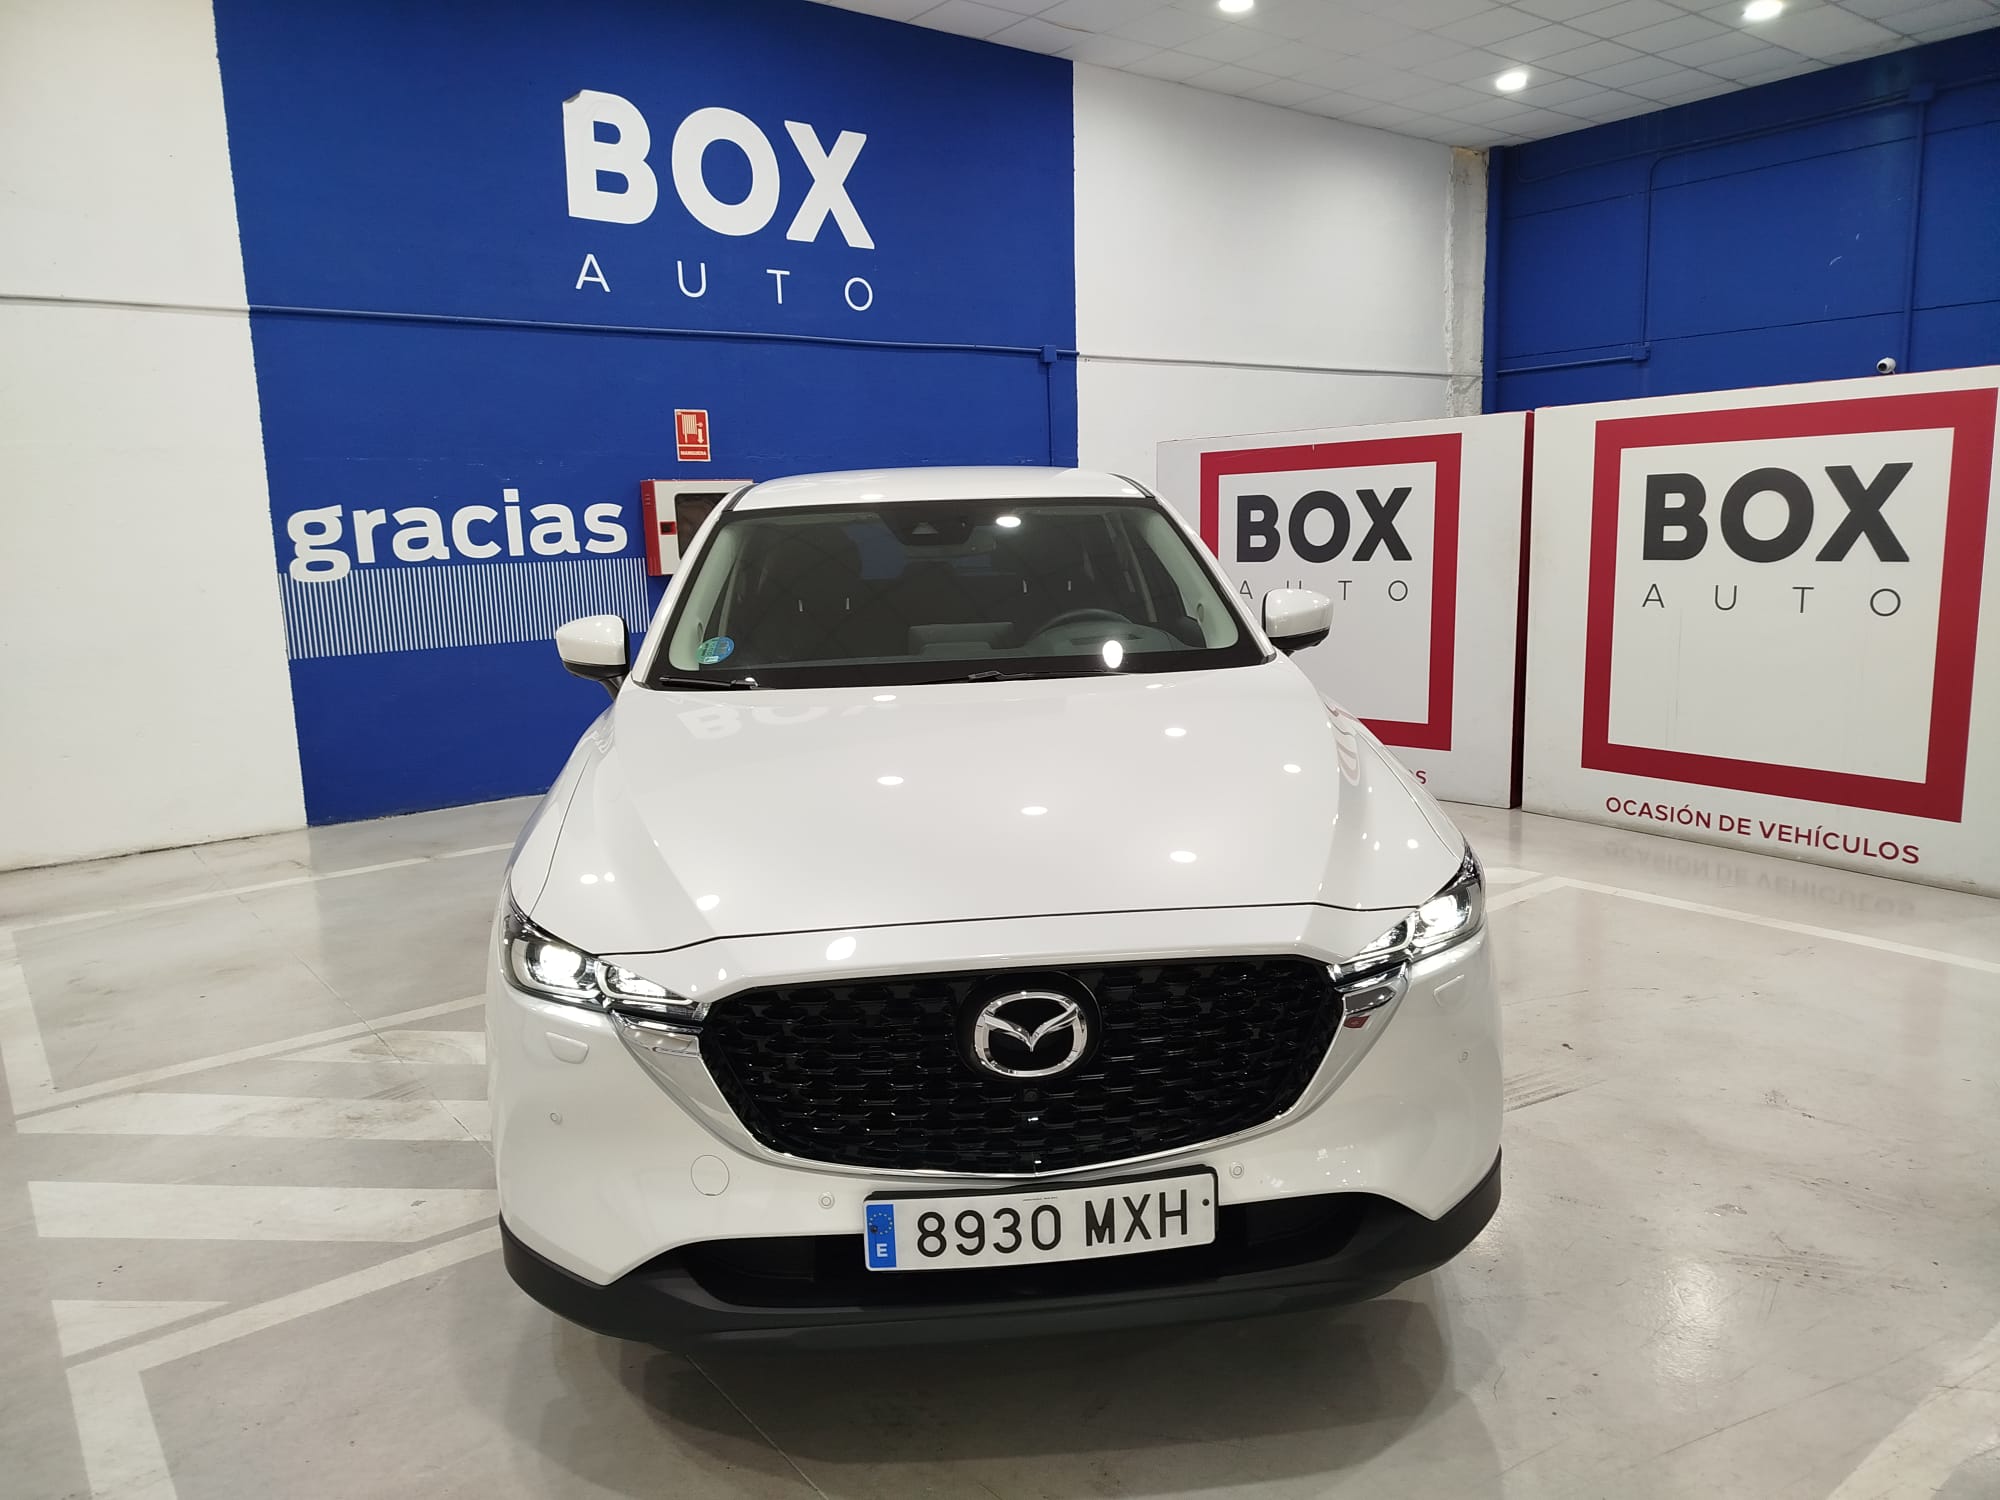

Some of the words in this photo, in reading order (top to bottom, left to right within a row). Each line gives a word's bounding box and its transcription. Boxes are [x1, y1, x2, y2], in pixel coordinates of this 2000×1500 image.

[562, 89, 875, 249] BOX
[576, 253, 873, 311] AUTO
[287, 488, 628, 582] gracias
[1236, 487, 1412, 563] BOX
[1642, 462, 1913, 563] BOX
[1642, 583, 1901, 617] AUTO
[1606, 796, 1711, 829] OCASIÓN
[1718, 815, 1751, 836] DE
[1758, 820, 1919, 864] VEHÍCULOS
[876, 1243, 888, 1258] E
[917, 1205, 1061, 1258] 8930
[1085, 1189, 1188, 1247] MXH
